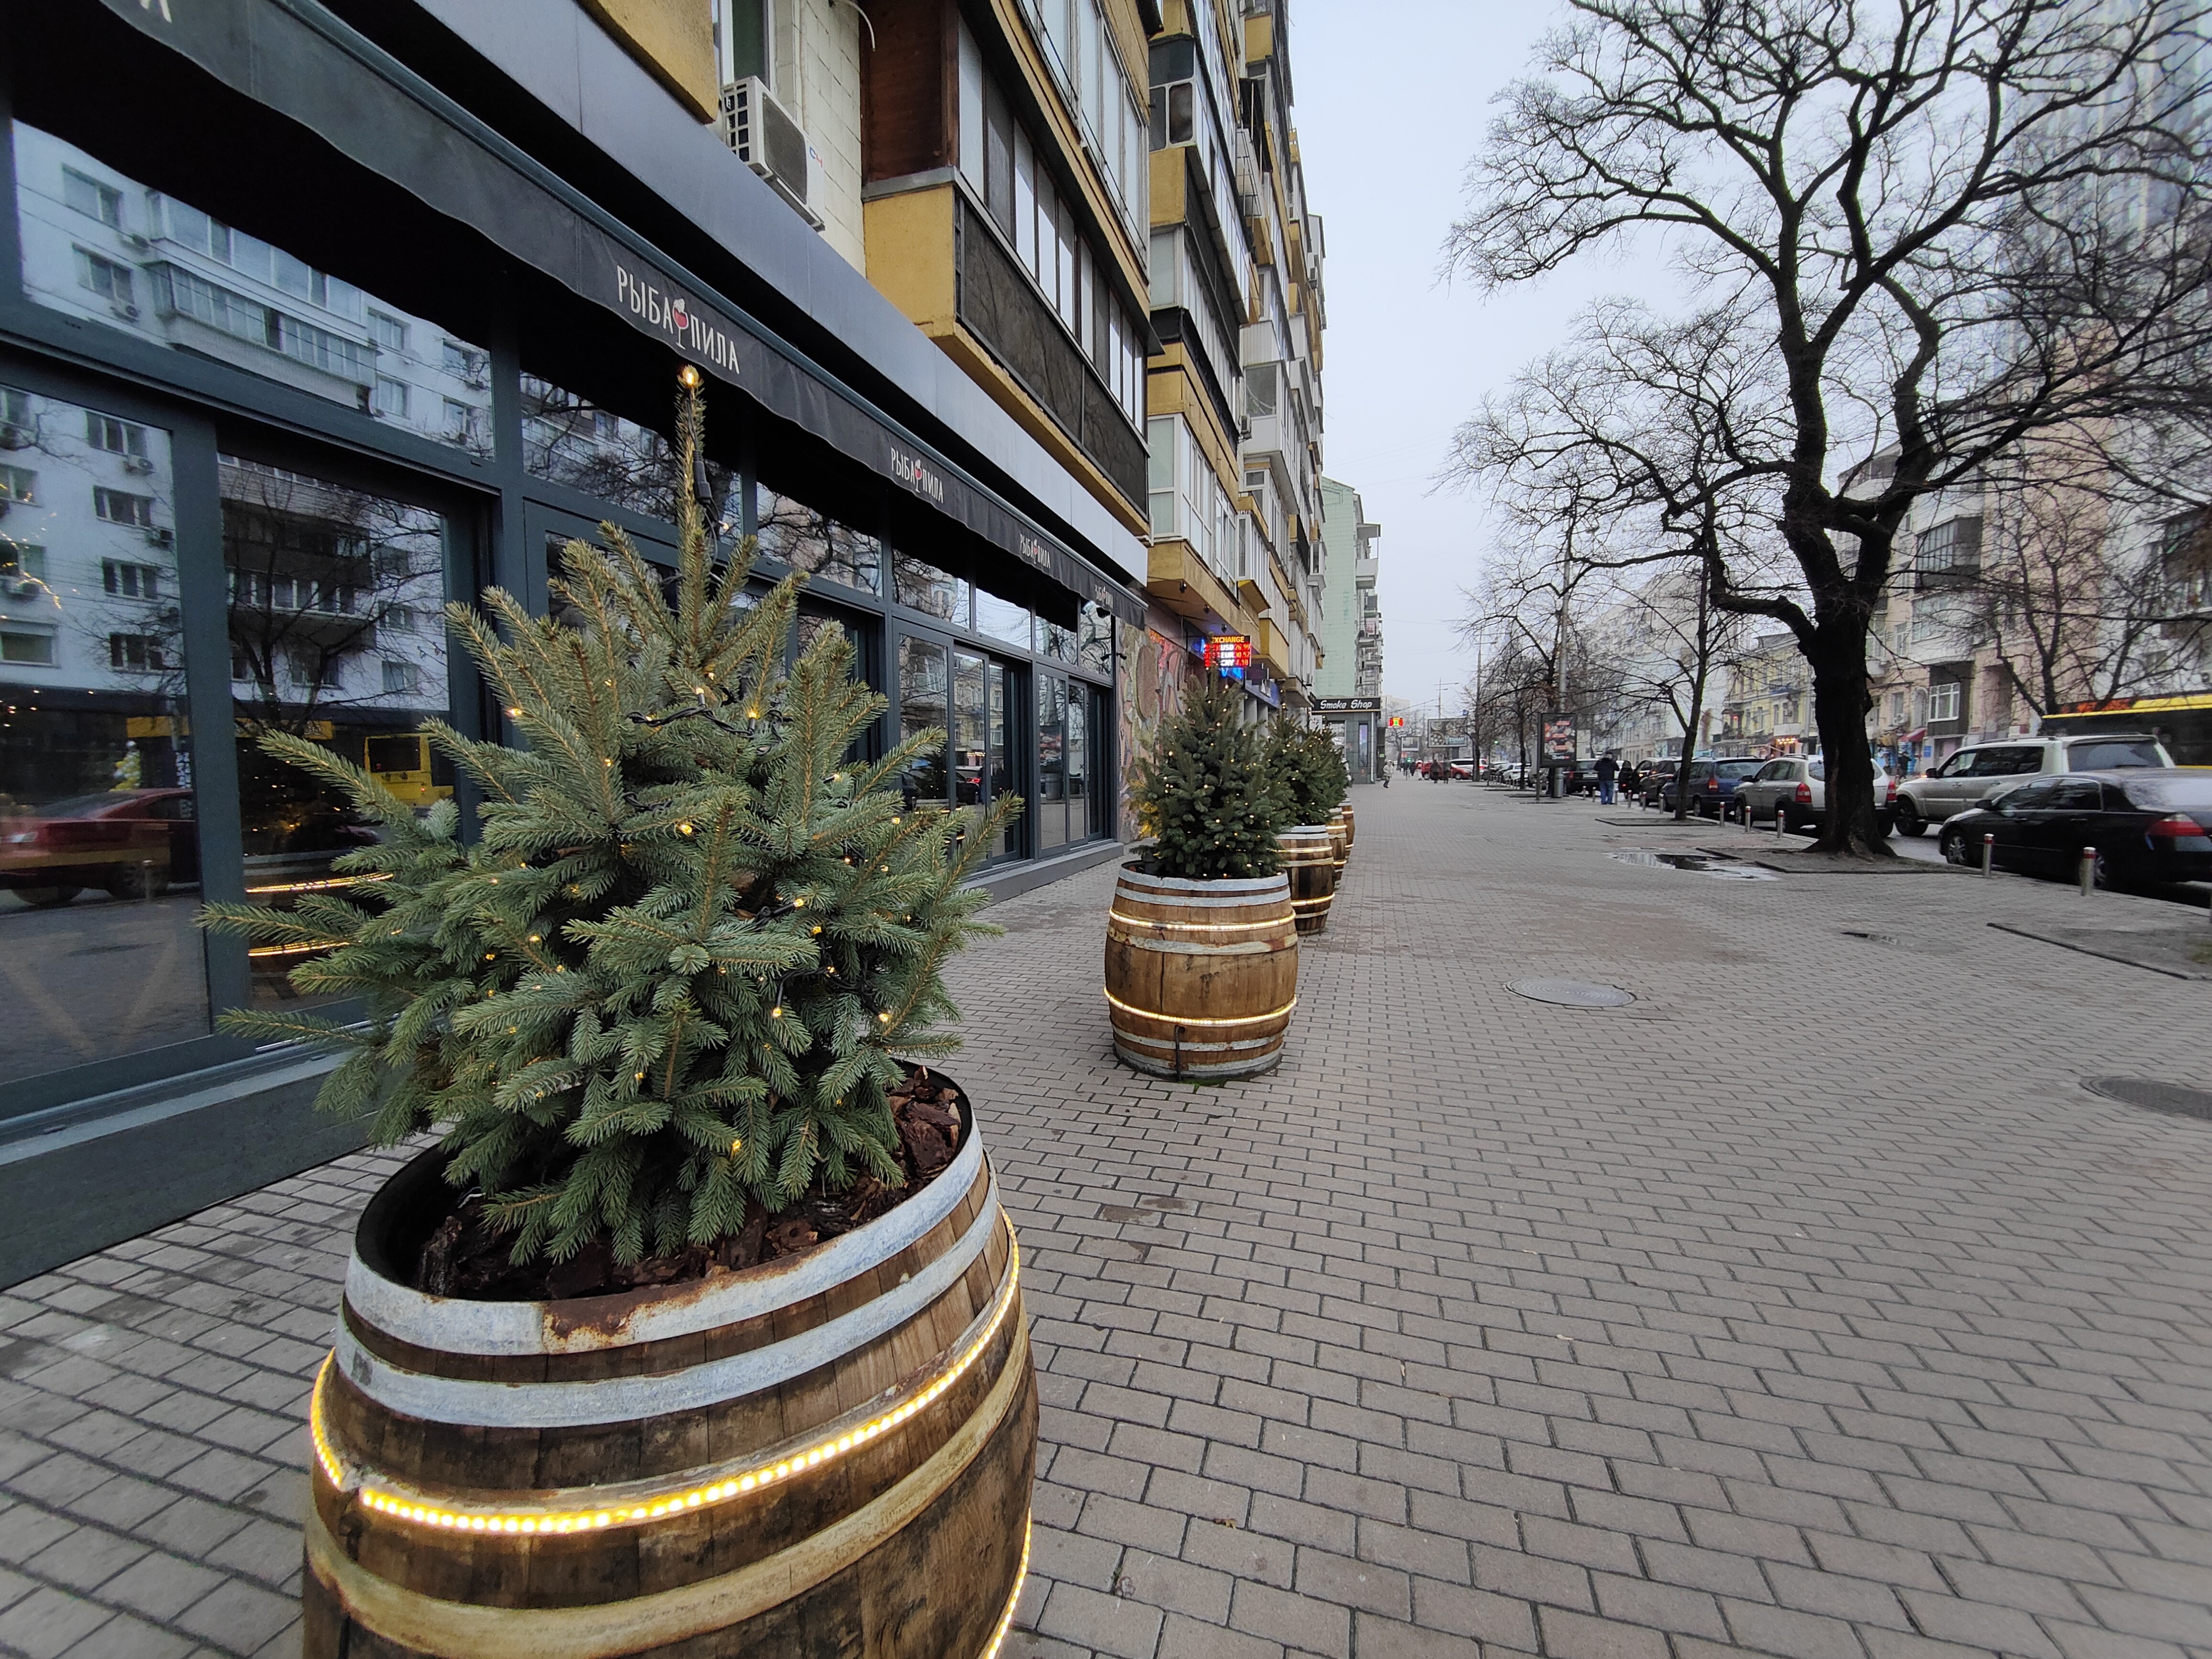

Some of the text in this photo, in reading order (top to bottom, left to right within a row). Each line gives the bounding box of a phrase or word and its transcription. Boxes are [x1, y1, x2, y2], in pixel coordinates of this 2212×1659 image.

[617, 265, 740, 374] РЫБА ПИЛА
[891, 447, 943, 504] РЫБА ПИЛА
[1020, 533, 1051, 569] РЫБА ПИЛА
[1320, 699, 1372, 709] Smoke Shop
